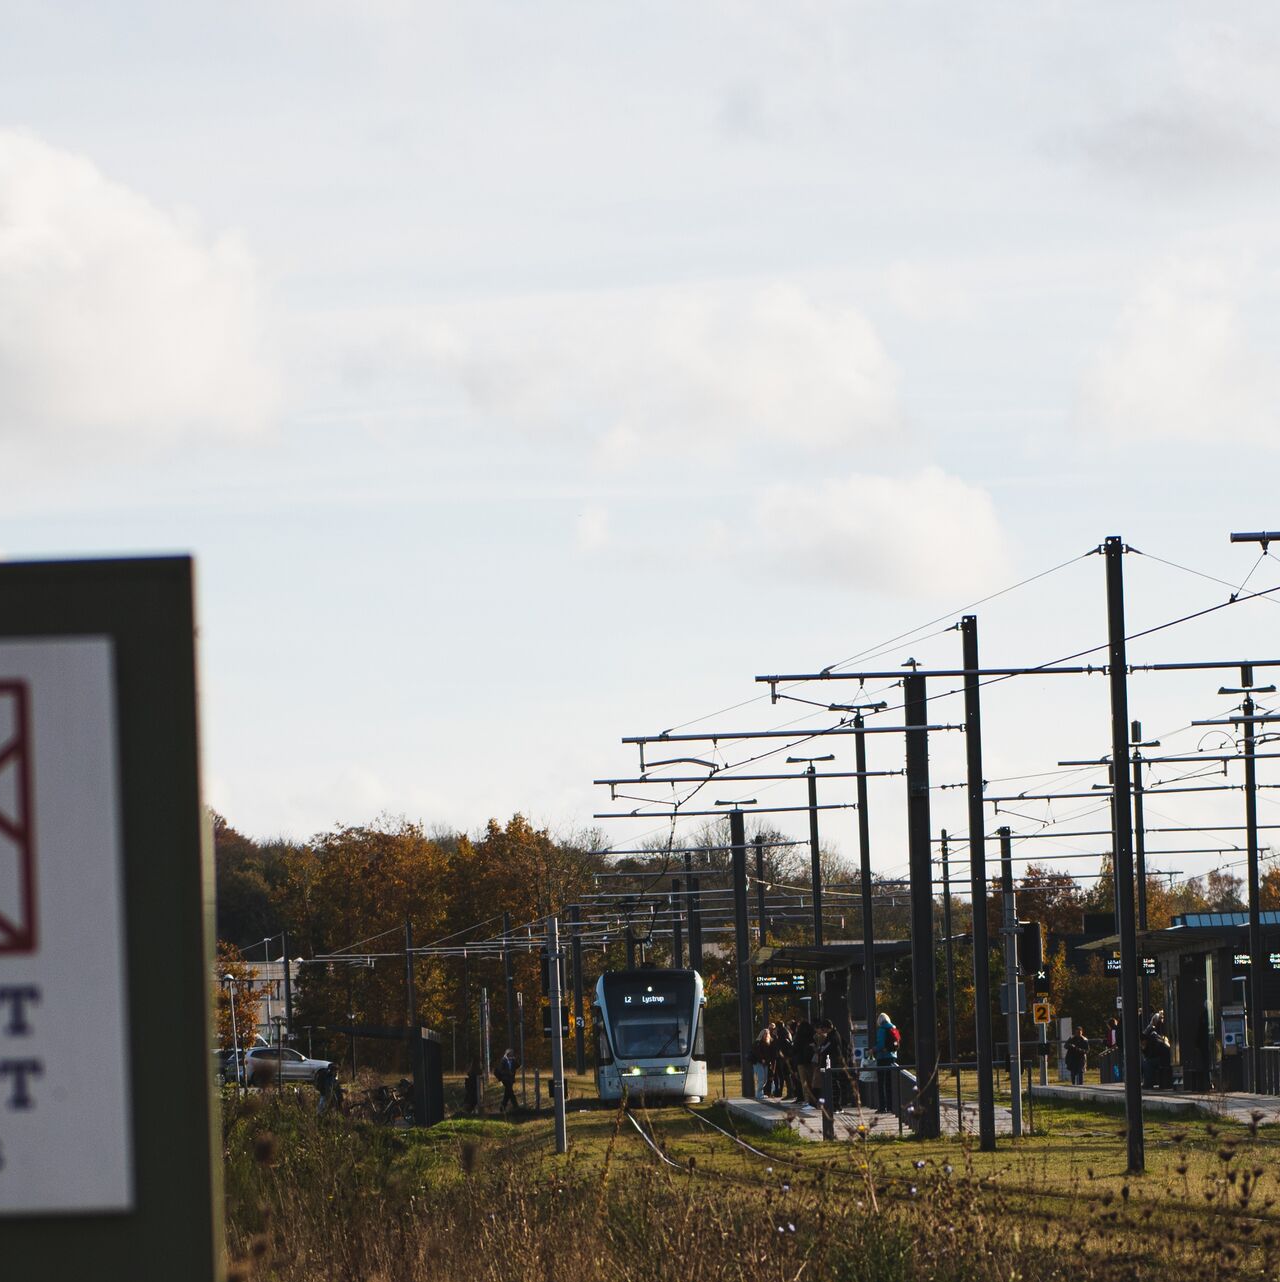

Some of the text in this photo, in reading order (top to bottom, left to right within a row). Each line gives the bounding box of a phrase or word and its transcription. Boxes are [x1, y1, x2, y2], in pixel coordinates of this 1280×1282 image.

[624, 995, 665, 1004] L2 Lystrup
[1036, 1006, 1048, 1020] 2
